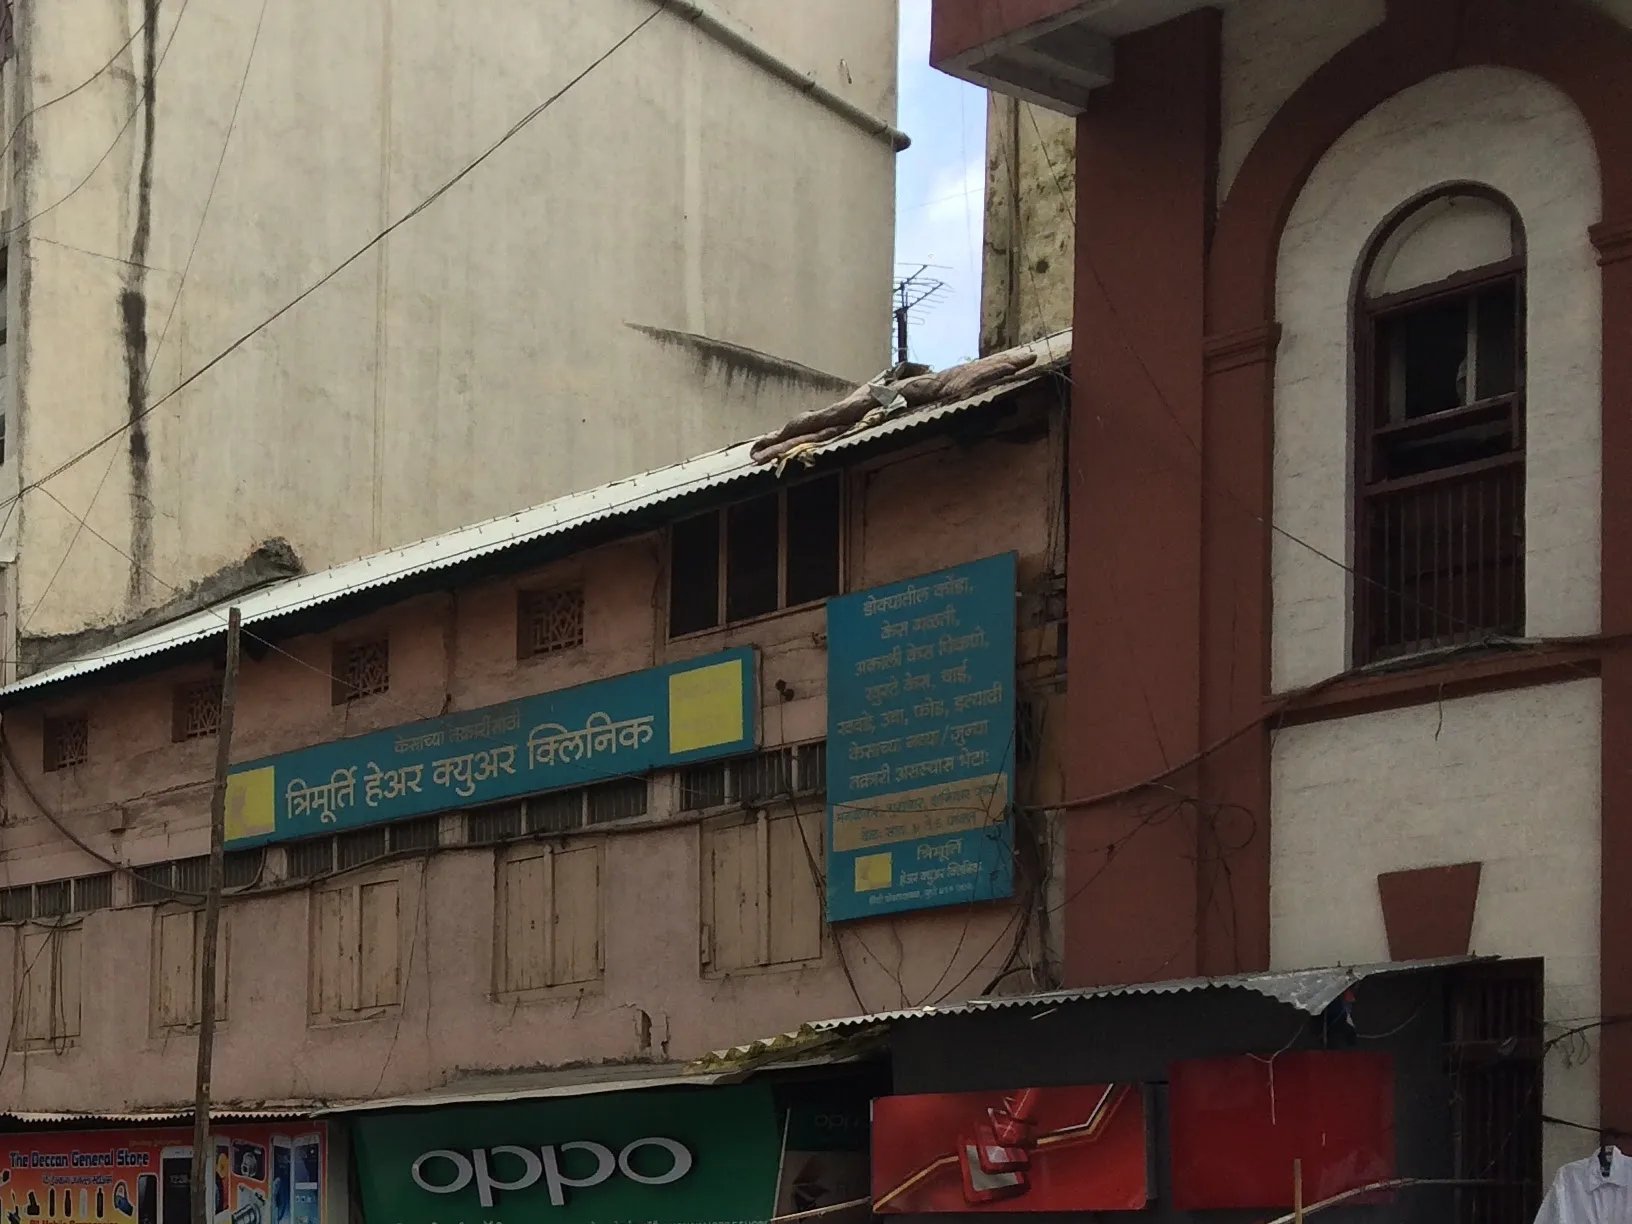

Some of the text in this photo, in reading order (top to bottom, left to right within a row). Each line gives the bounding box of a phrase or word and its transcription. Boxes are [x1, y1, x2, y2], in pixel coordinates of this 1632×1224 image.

[364, 761, 423, 808] हेअर
[432, 744, 518, 797] क्युअर
[527, 711, 655, 770] क्लिनिक
[11, 1148, 149, 1168] The Deccan General Store
[411, 1136, 692, 1207] oppo
